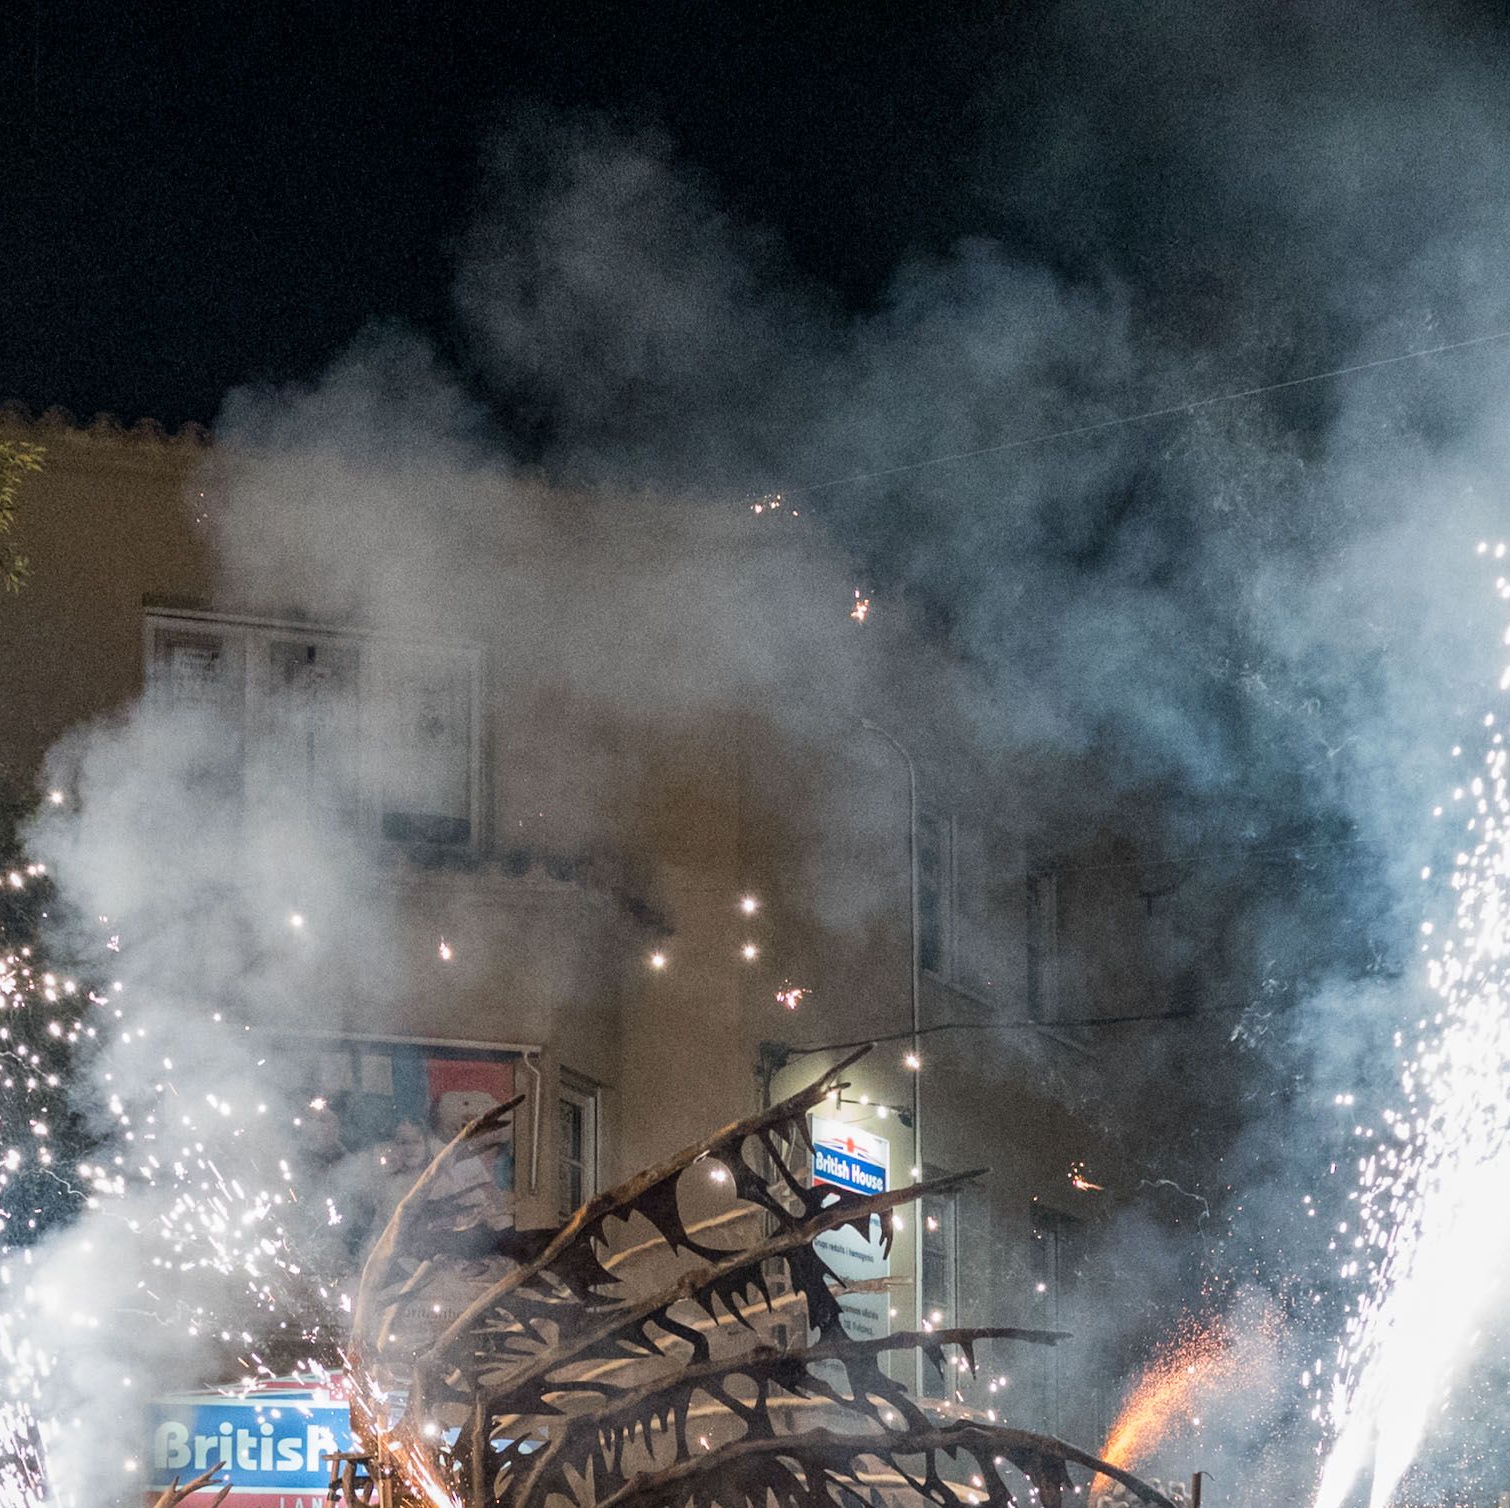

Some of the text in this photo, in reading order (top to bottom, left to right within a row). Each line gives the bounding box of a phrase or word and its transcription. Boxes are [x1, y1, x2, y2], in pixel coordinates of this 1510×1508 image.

[816, 1151, 884, 1192] British House
[154, 1421, 338, 1472] British
